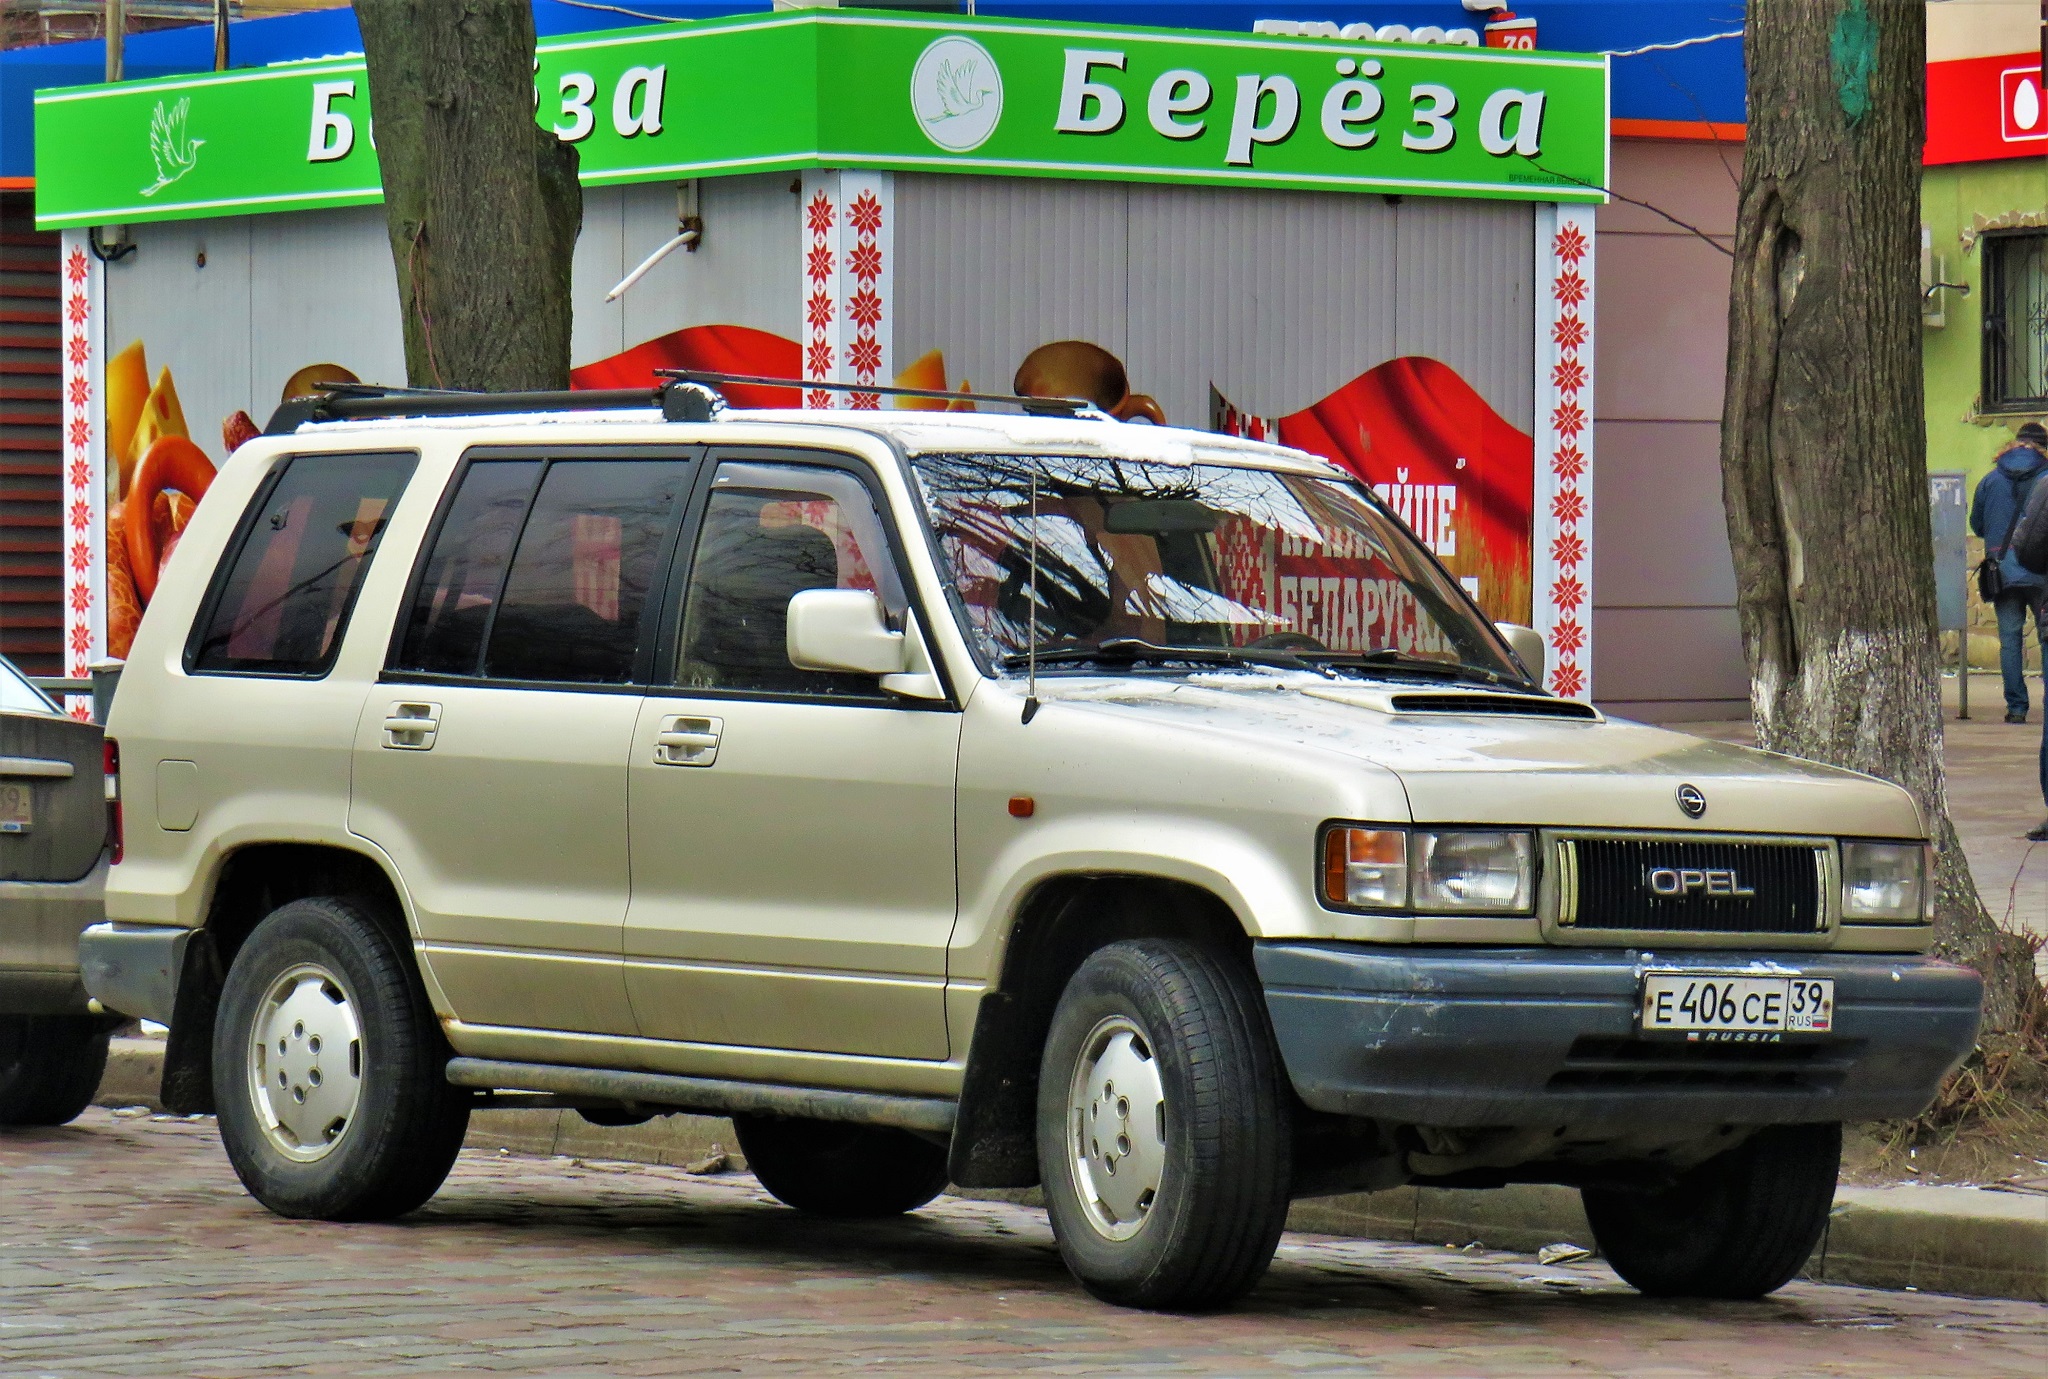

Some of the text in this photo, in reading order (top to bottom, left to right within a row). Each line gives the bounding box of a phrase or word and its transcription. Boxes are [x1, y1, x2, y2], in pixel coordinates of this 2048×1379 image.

[308, 57, 667, 163] Бза
[1054, 48, 1546, 167] Берёза
[1508, 173, 1556, 184] ВРЕМЕННАЯ
[1651, 869, 1756, 896] OPEL
[1790, 982, 1823, 1014] 39
[1788, 1017, 1812, 1027] RUS
[1705, 1032, 1781, 1042] RUSSIA
